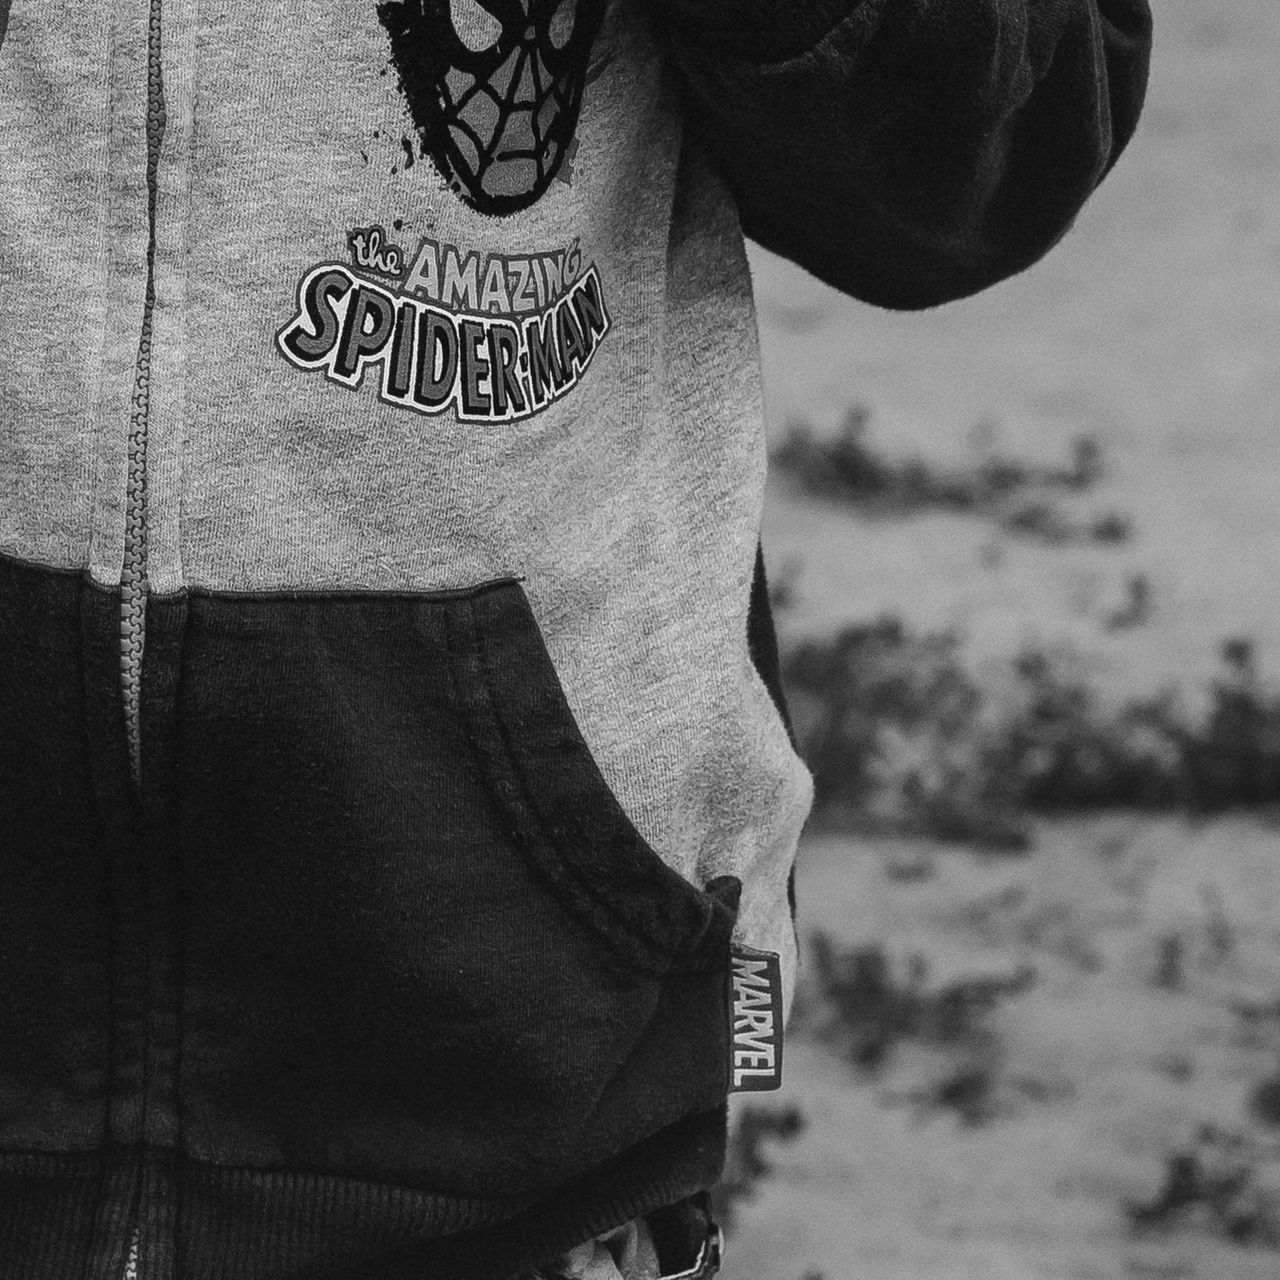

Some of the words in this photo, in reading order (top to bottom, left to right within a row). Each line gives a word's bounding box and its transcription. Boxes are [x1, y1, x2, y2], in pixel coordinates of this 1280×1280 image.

[351, 230, 403, 276] the
[402, 242, 581, 313] AMAZING
[731, 956, 776, 1088] MARVEL
